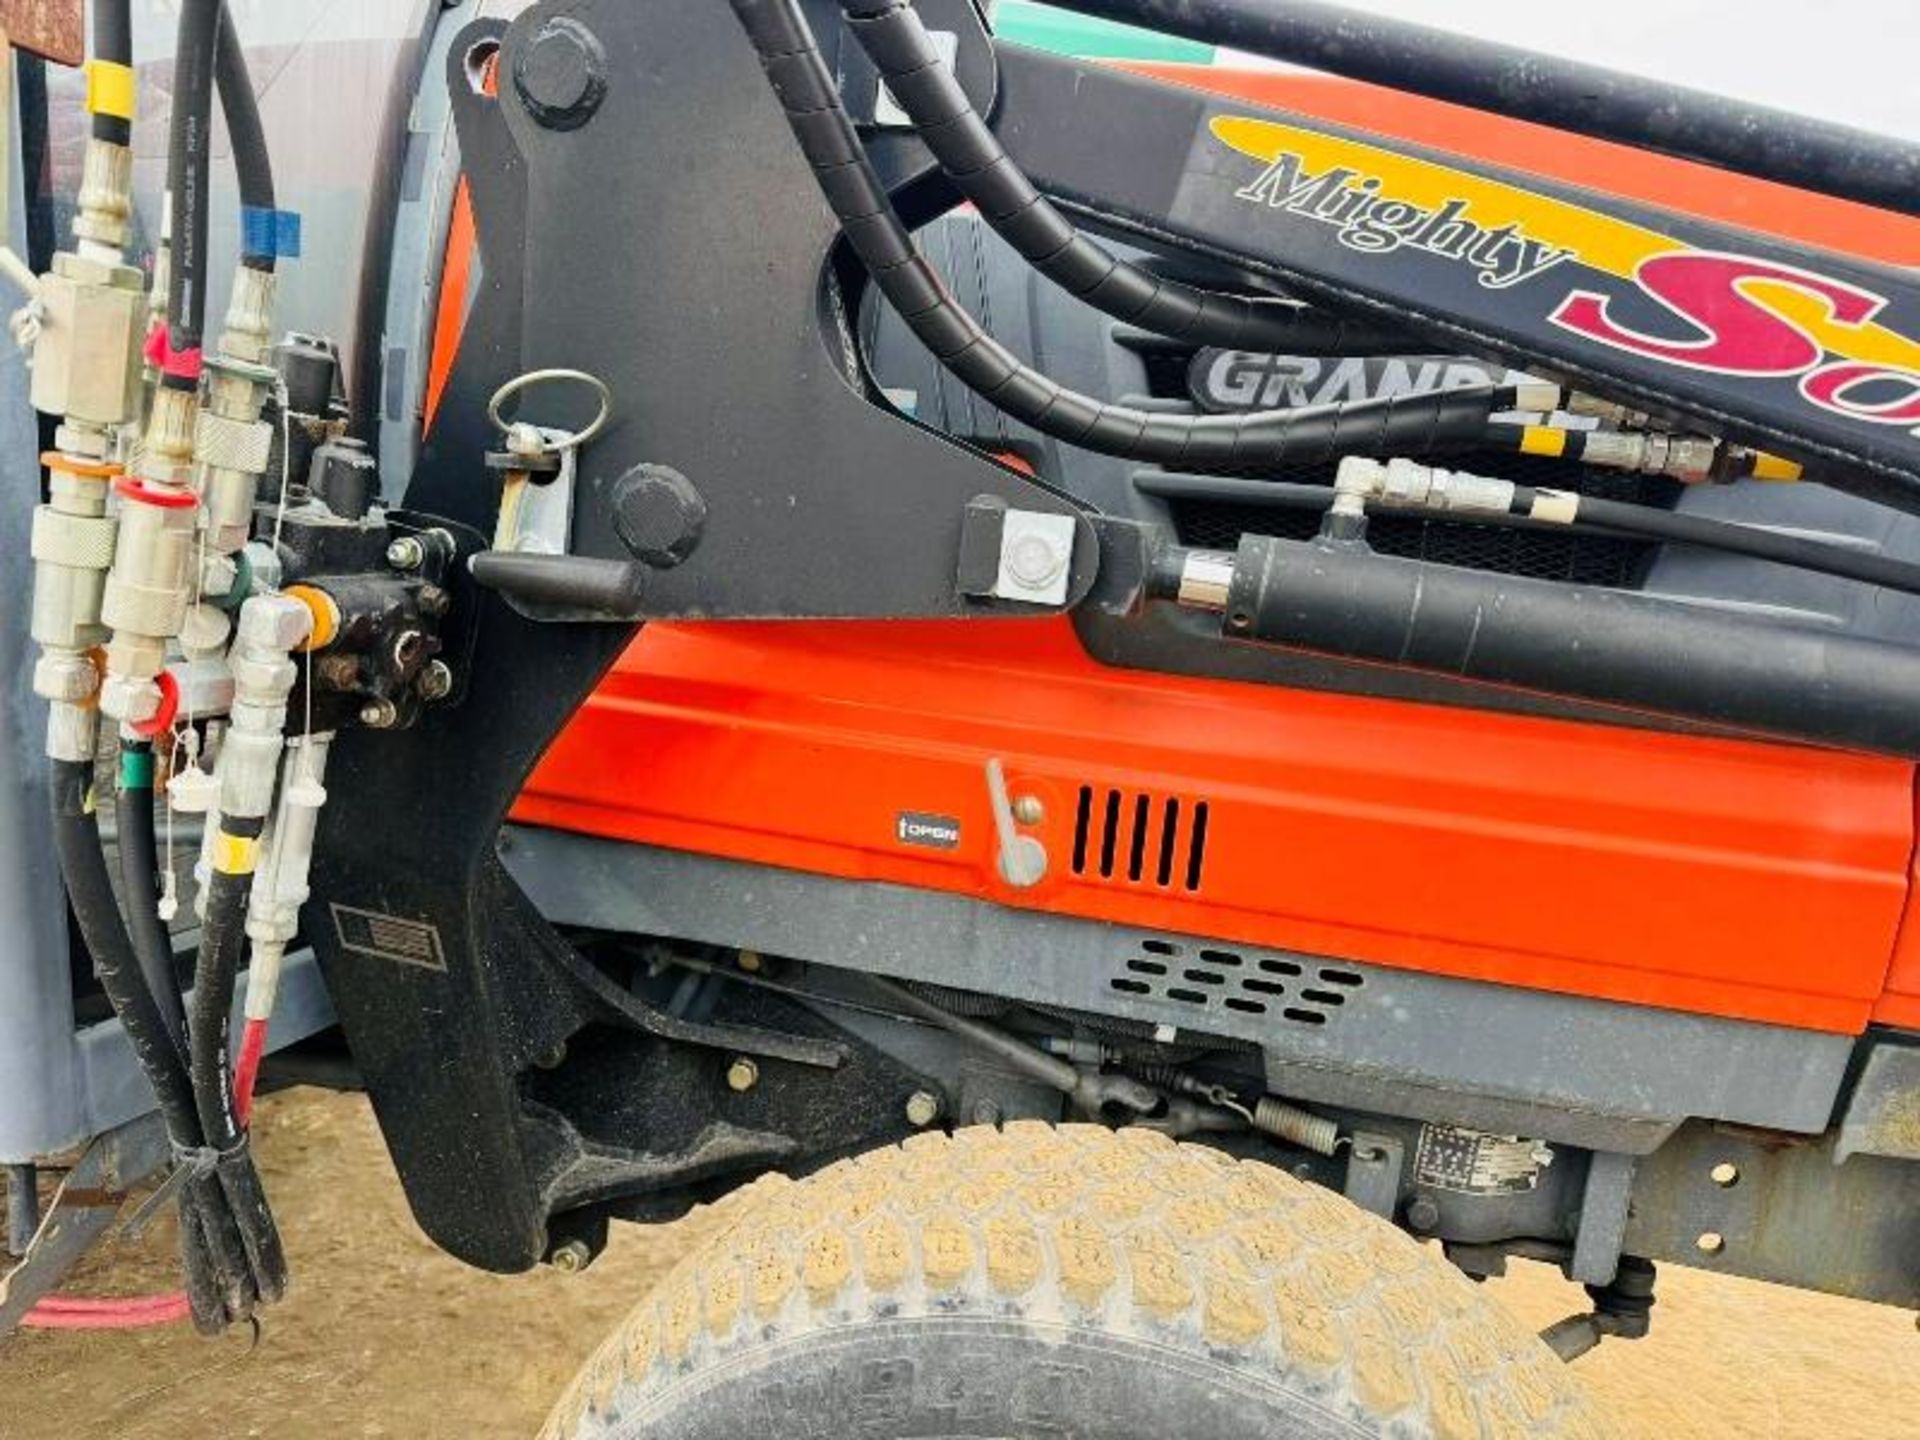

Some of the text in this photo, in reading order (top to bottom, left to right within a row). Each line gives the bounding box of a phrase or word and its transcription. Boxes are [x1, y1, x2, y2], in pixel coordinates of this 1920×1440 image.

[1237, 152, 1919, 434] Mighty So
[909, 825, 958, 841] OPEN
